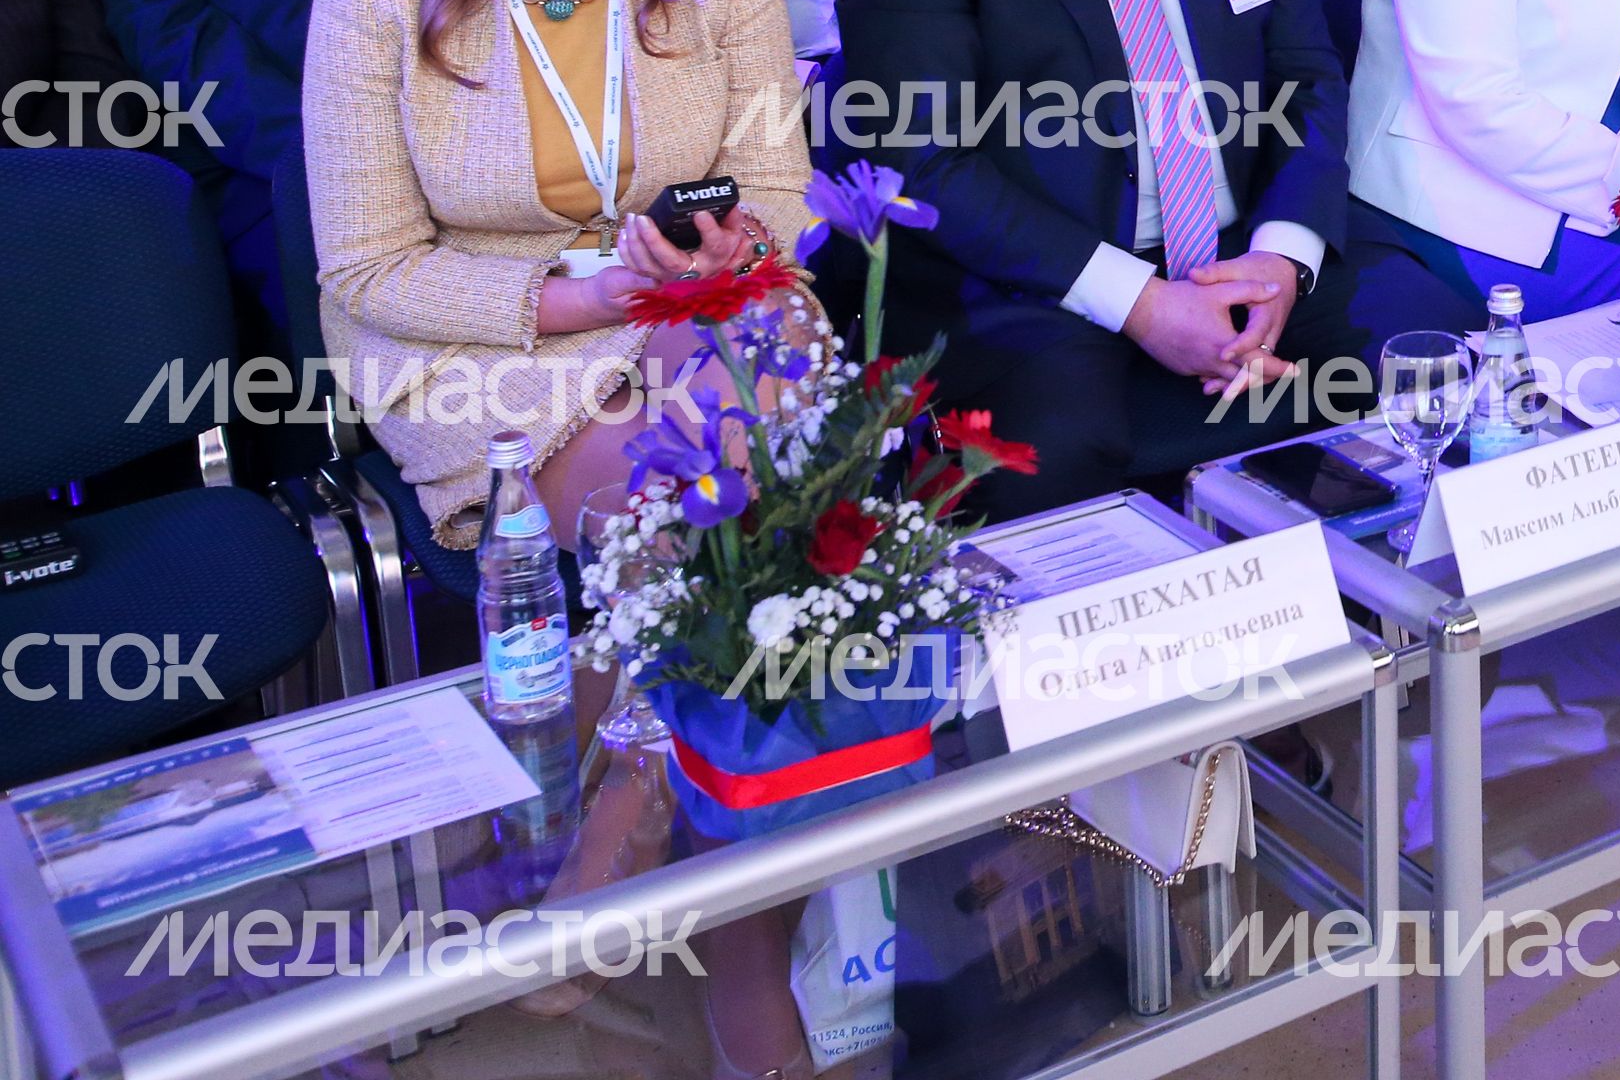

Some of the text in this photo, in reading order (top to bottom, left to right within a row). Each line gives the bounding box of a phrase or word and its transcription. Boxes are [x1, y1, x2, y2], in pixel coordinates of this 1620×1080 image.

[673, 184, 732, 203] i-vote
[1479, 512, 1566, 550] Максим
[4, 559, 76, 587] i-vote
[1057, 556, 1266, 640] ПЕЛЕХАТАЯ
[1039, 601, 1305, 698] Ольга Анатольевна
[851, 1021, 894, 1037] Россия,
